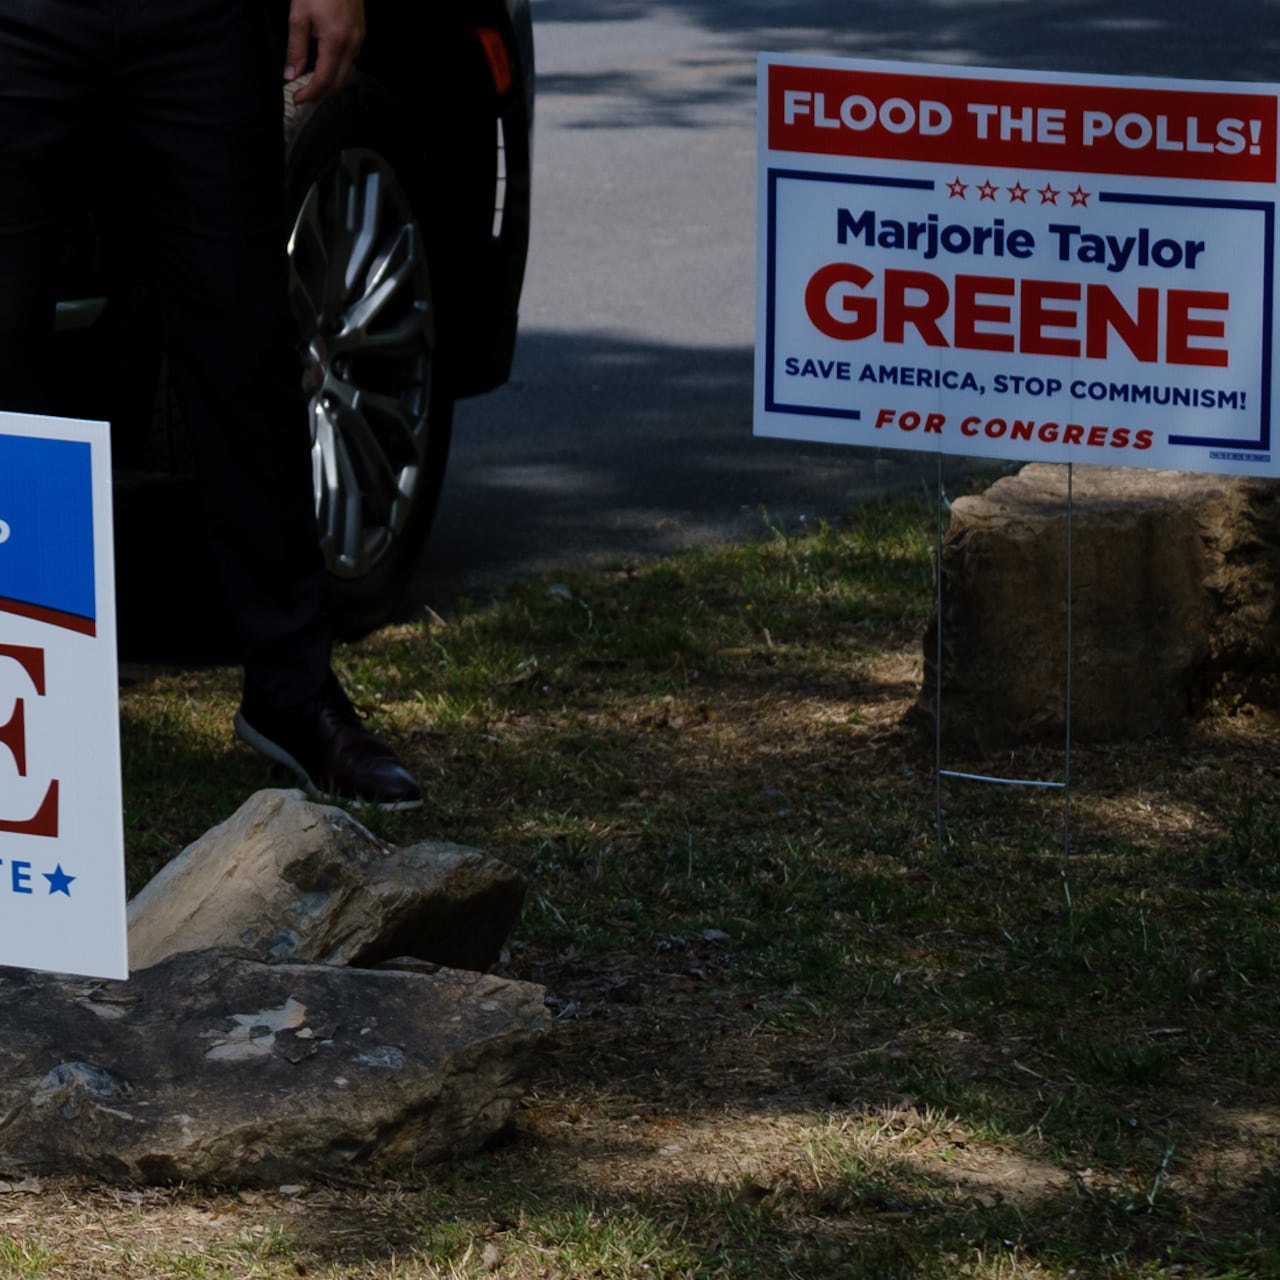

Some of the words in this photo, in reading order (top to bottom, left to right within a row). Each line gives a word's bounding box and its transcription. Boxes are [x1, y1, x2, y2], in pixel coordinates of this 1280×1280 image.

[783, 89, 953, 136] FLOOD
[967, 103, 1067, 144] THE
[1082, 110, 1263, 156] POLLS!
[836, 208, 1035, 259] Marjorie
[1048, 223, 1205, 273] Taylor
[804, 262, 1230, 368] GREENE
[784, 357, 851, 382] SAVE
[858, 364, 986, 395] AMERICA,
[993, 375, 1063, 397] STOP
[1069, 380, 1247, 411] COMMUNISM!
[874, 408, 946, 434] FOR
[960, 416, 1155, 451] CONGRESS
